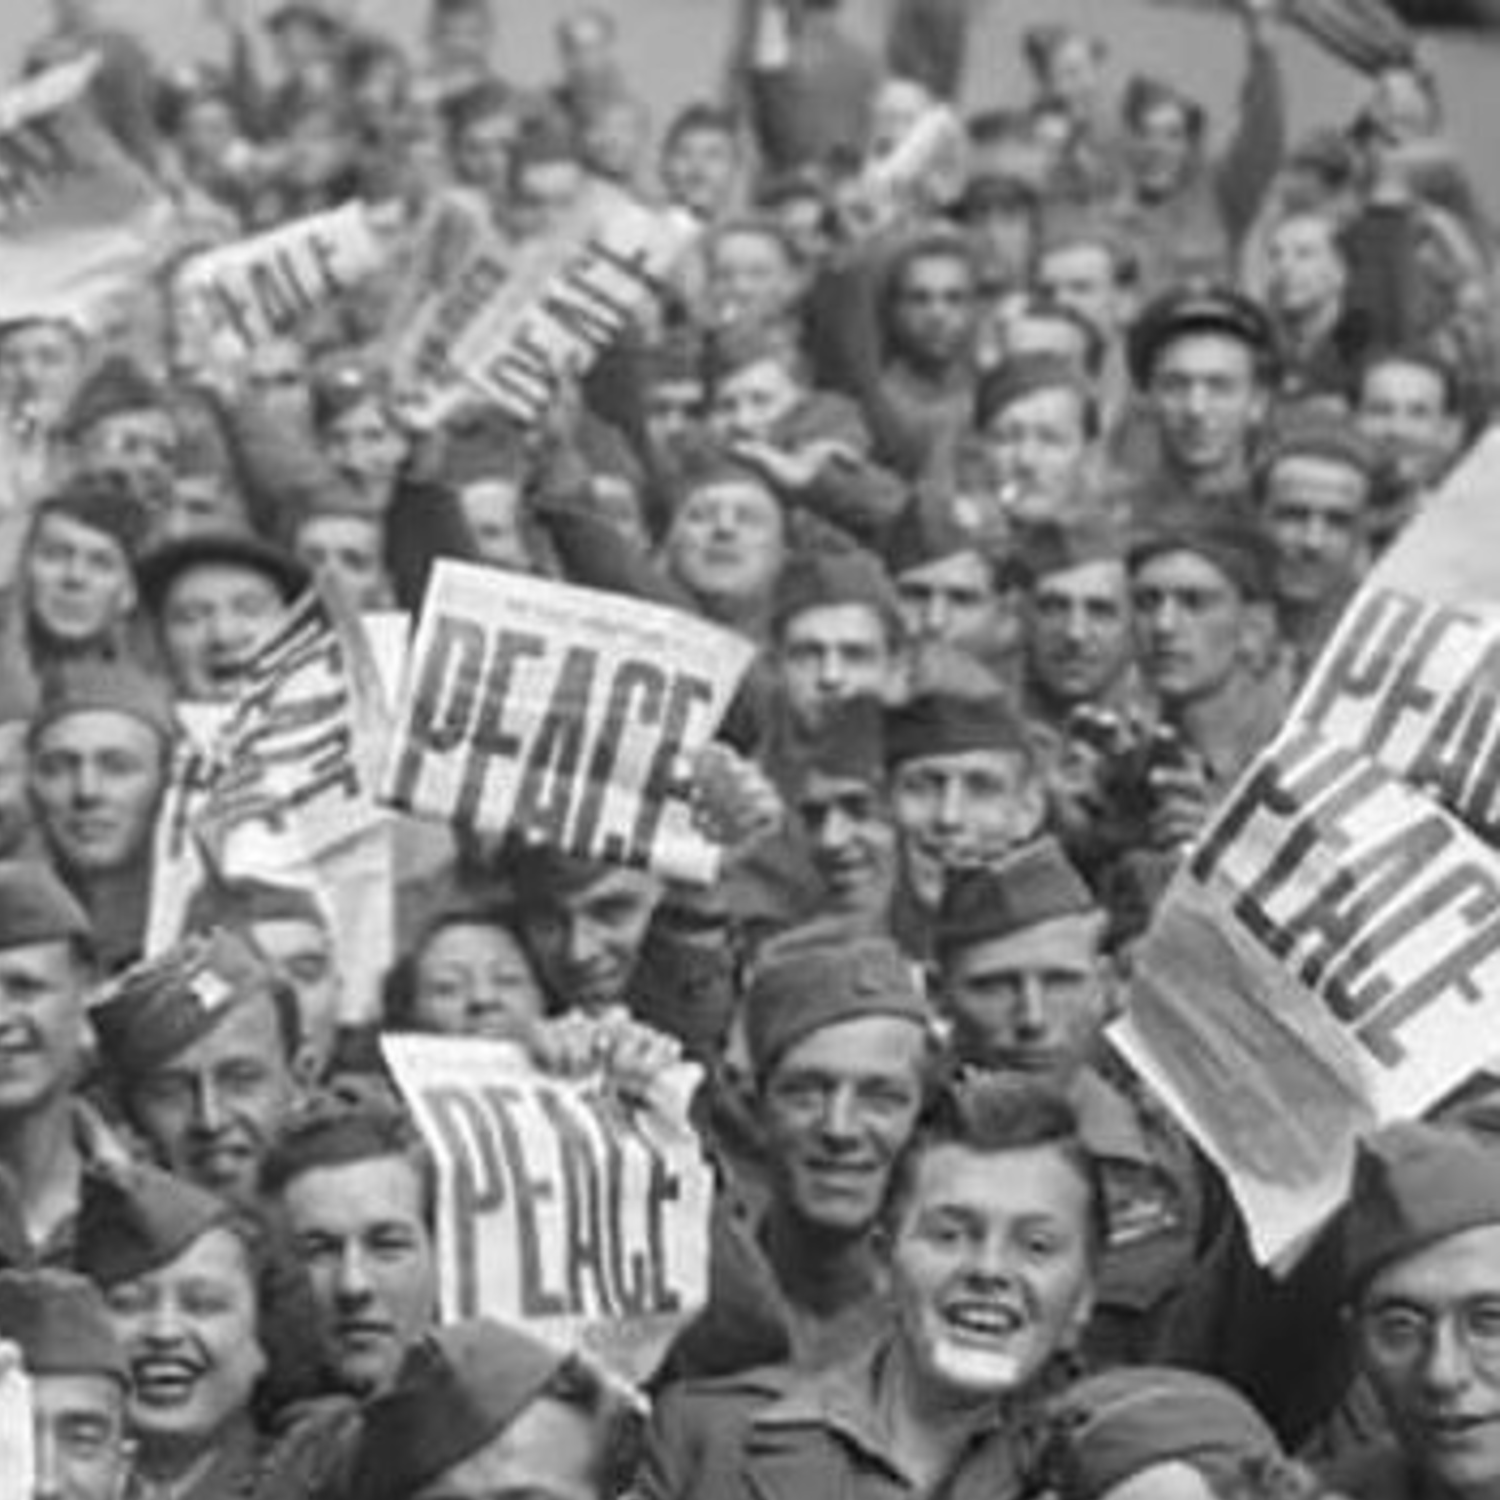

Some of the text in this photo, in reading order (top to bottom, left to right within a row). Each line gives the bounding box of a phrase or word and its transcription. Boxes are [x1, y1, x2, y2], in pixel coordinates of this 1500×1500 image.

[395, 614, 713, 870] PEACE
[1191, 735, 1500, 1068] PEACE
[420, 1086, 681, 1318] PEACE
